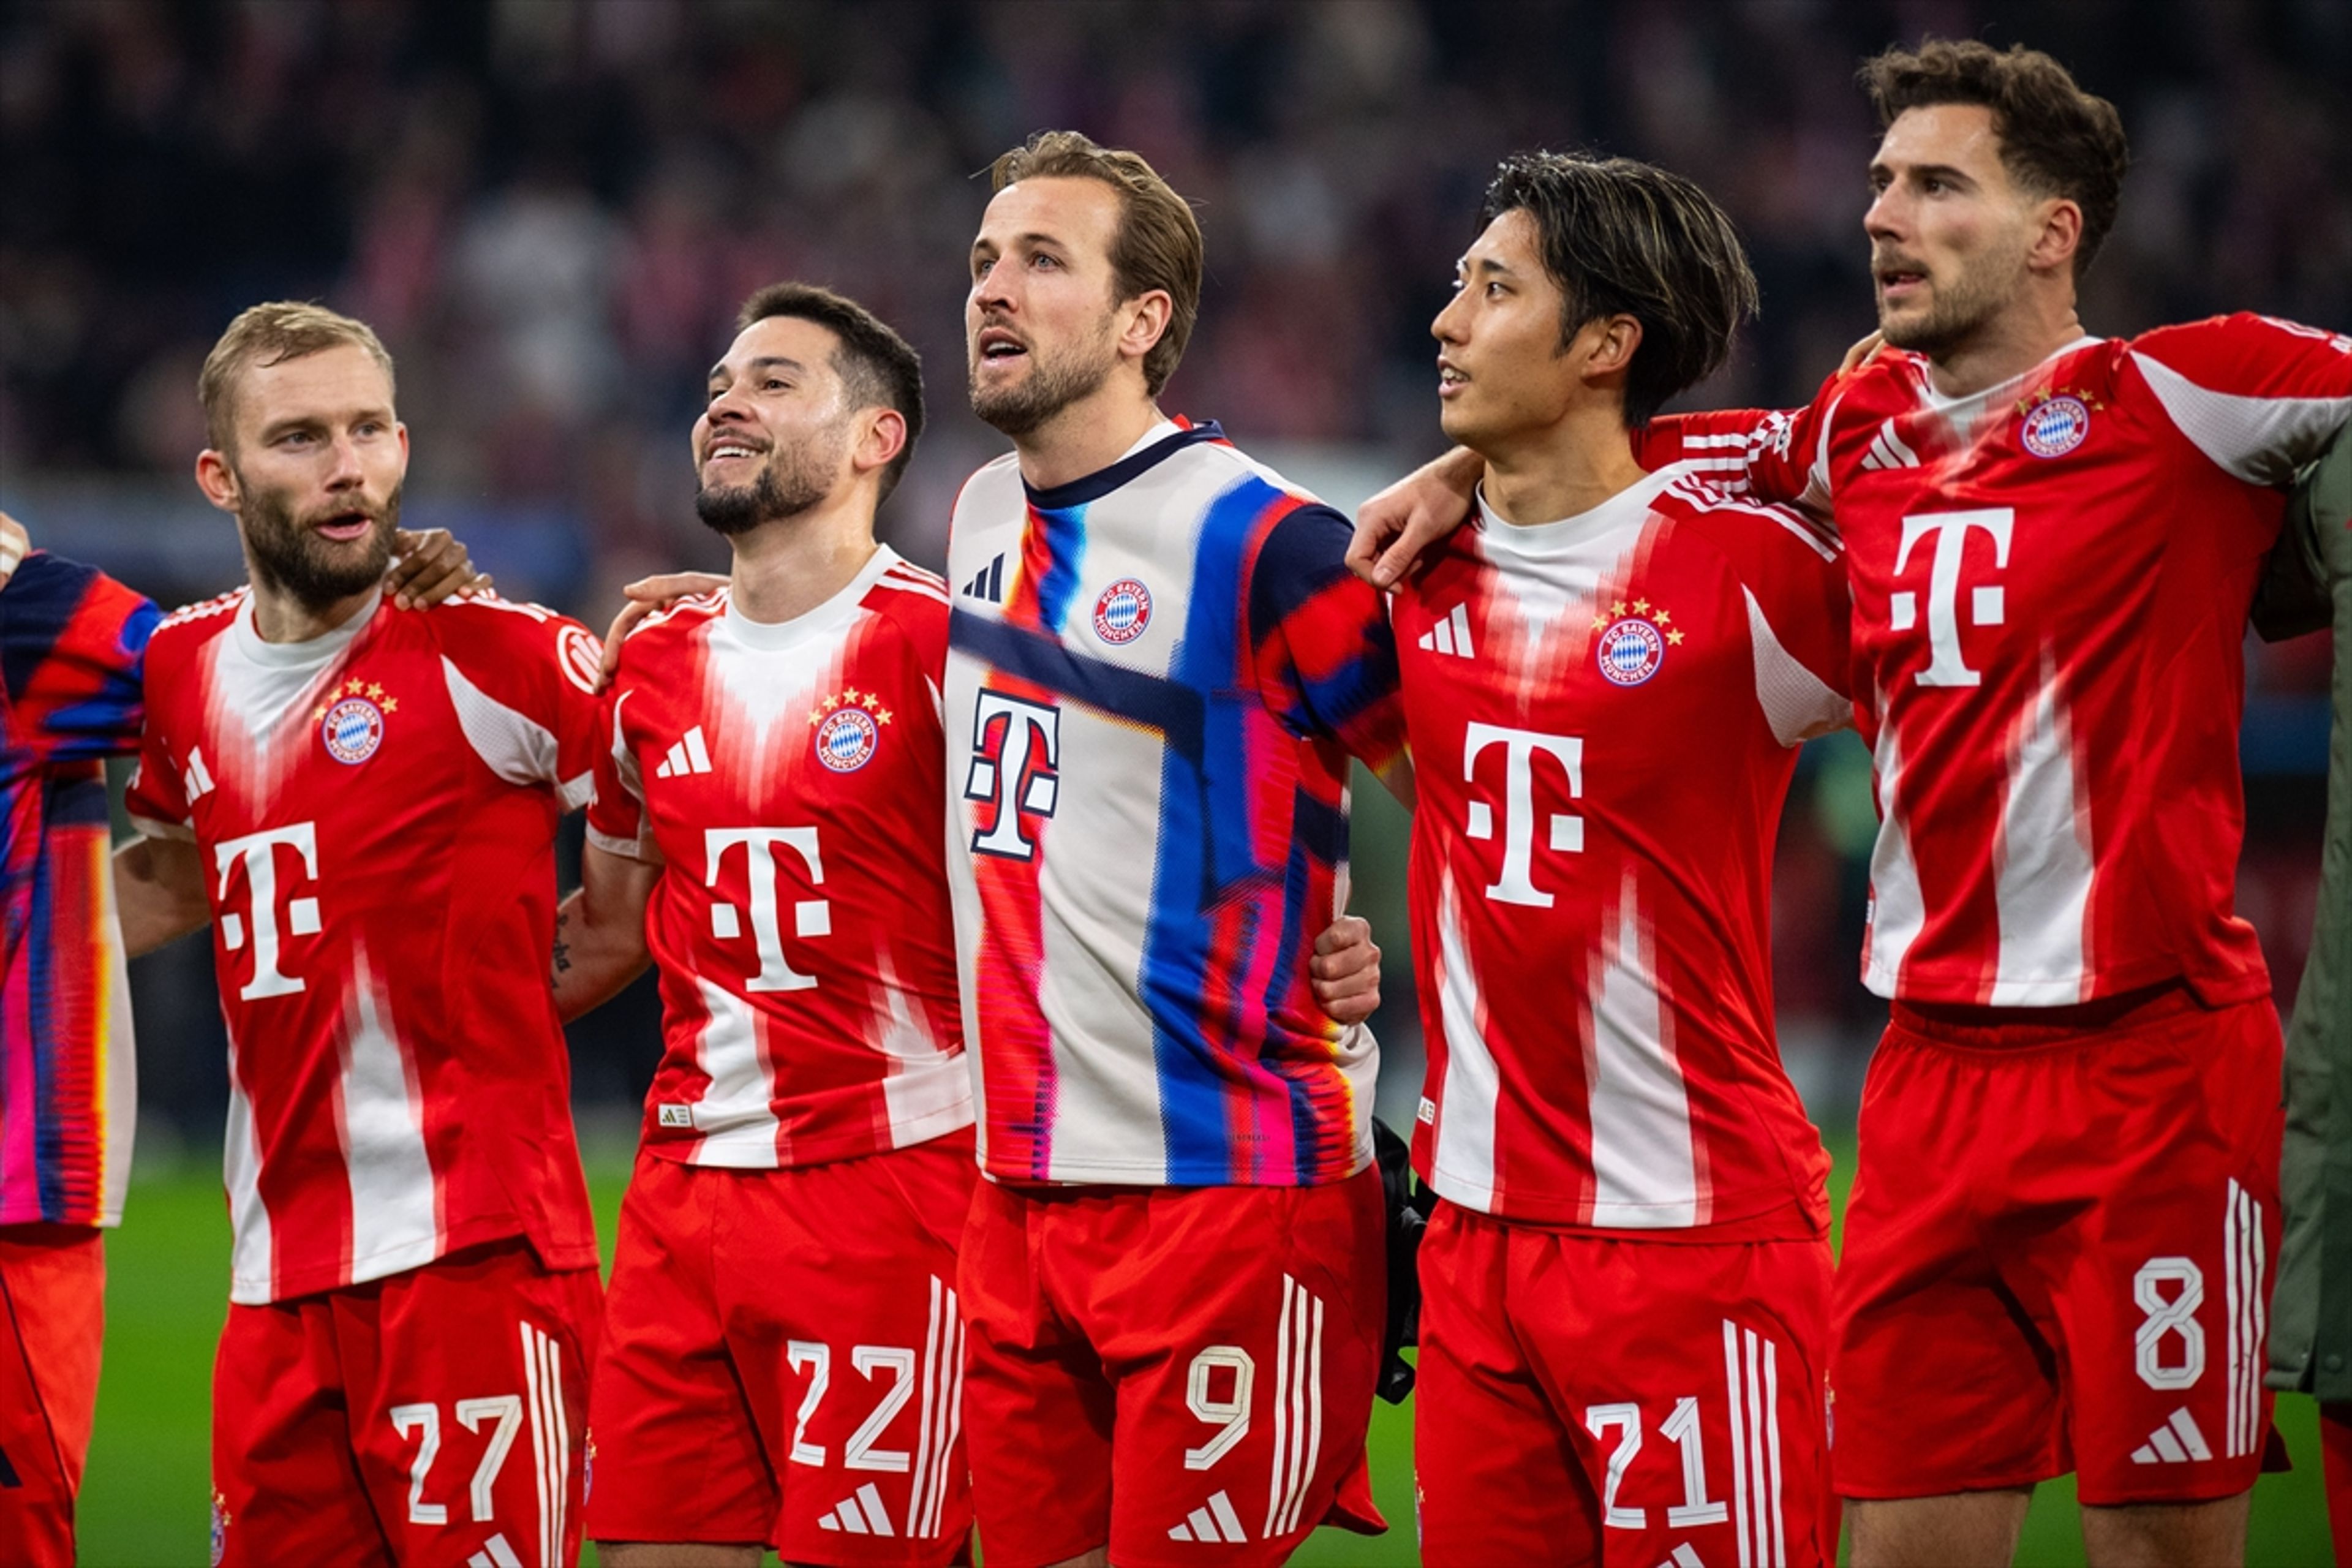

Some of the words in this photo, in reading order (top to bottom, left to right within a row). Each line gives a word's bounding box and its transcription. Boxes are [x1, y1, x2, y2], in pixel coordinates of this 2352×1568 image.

[2030, 412, 2043, 426] FC
[2046, 401, 2083, 424] BAYERN
[1096, 615, 1143, 640] MÜNCHEN
[1101, 590, 1114, 604] FC
[1117, 583, 1148, 610] BAYERN
[1607, 630, 1620, 644] FC
[1622, 624, 1659, 651] BAYERN
[1890, 507, 2015, 687] T
[328, 712, 340, 728] FC
[341, 704, 379, 726] BAYERN
[823, 723, 835, 736] FC
[837, 712, 872, 736] BAYERN
[1602, 655, 1653, 681] MÜNCHEN
[820, 746, 870, 769] MÜNCHEN
[963, 687, 1060, 862] T
[1464, 721, 1584, 908] T
[215, 821, 322, 1001] T
[705, 827, 831, 992] T
[2134, 1256, 2205, 1390] 8
[390, 1394, 524, 1525] 27
[786, 1340, 916, 1472] 22
[1185, 1345, 1255, 1470] 9
[1585, 1396, 1728, 1529] 21
